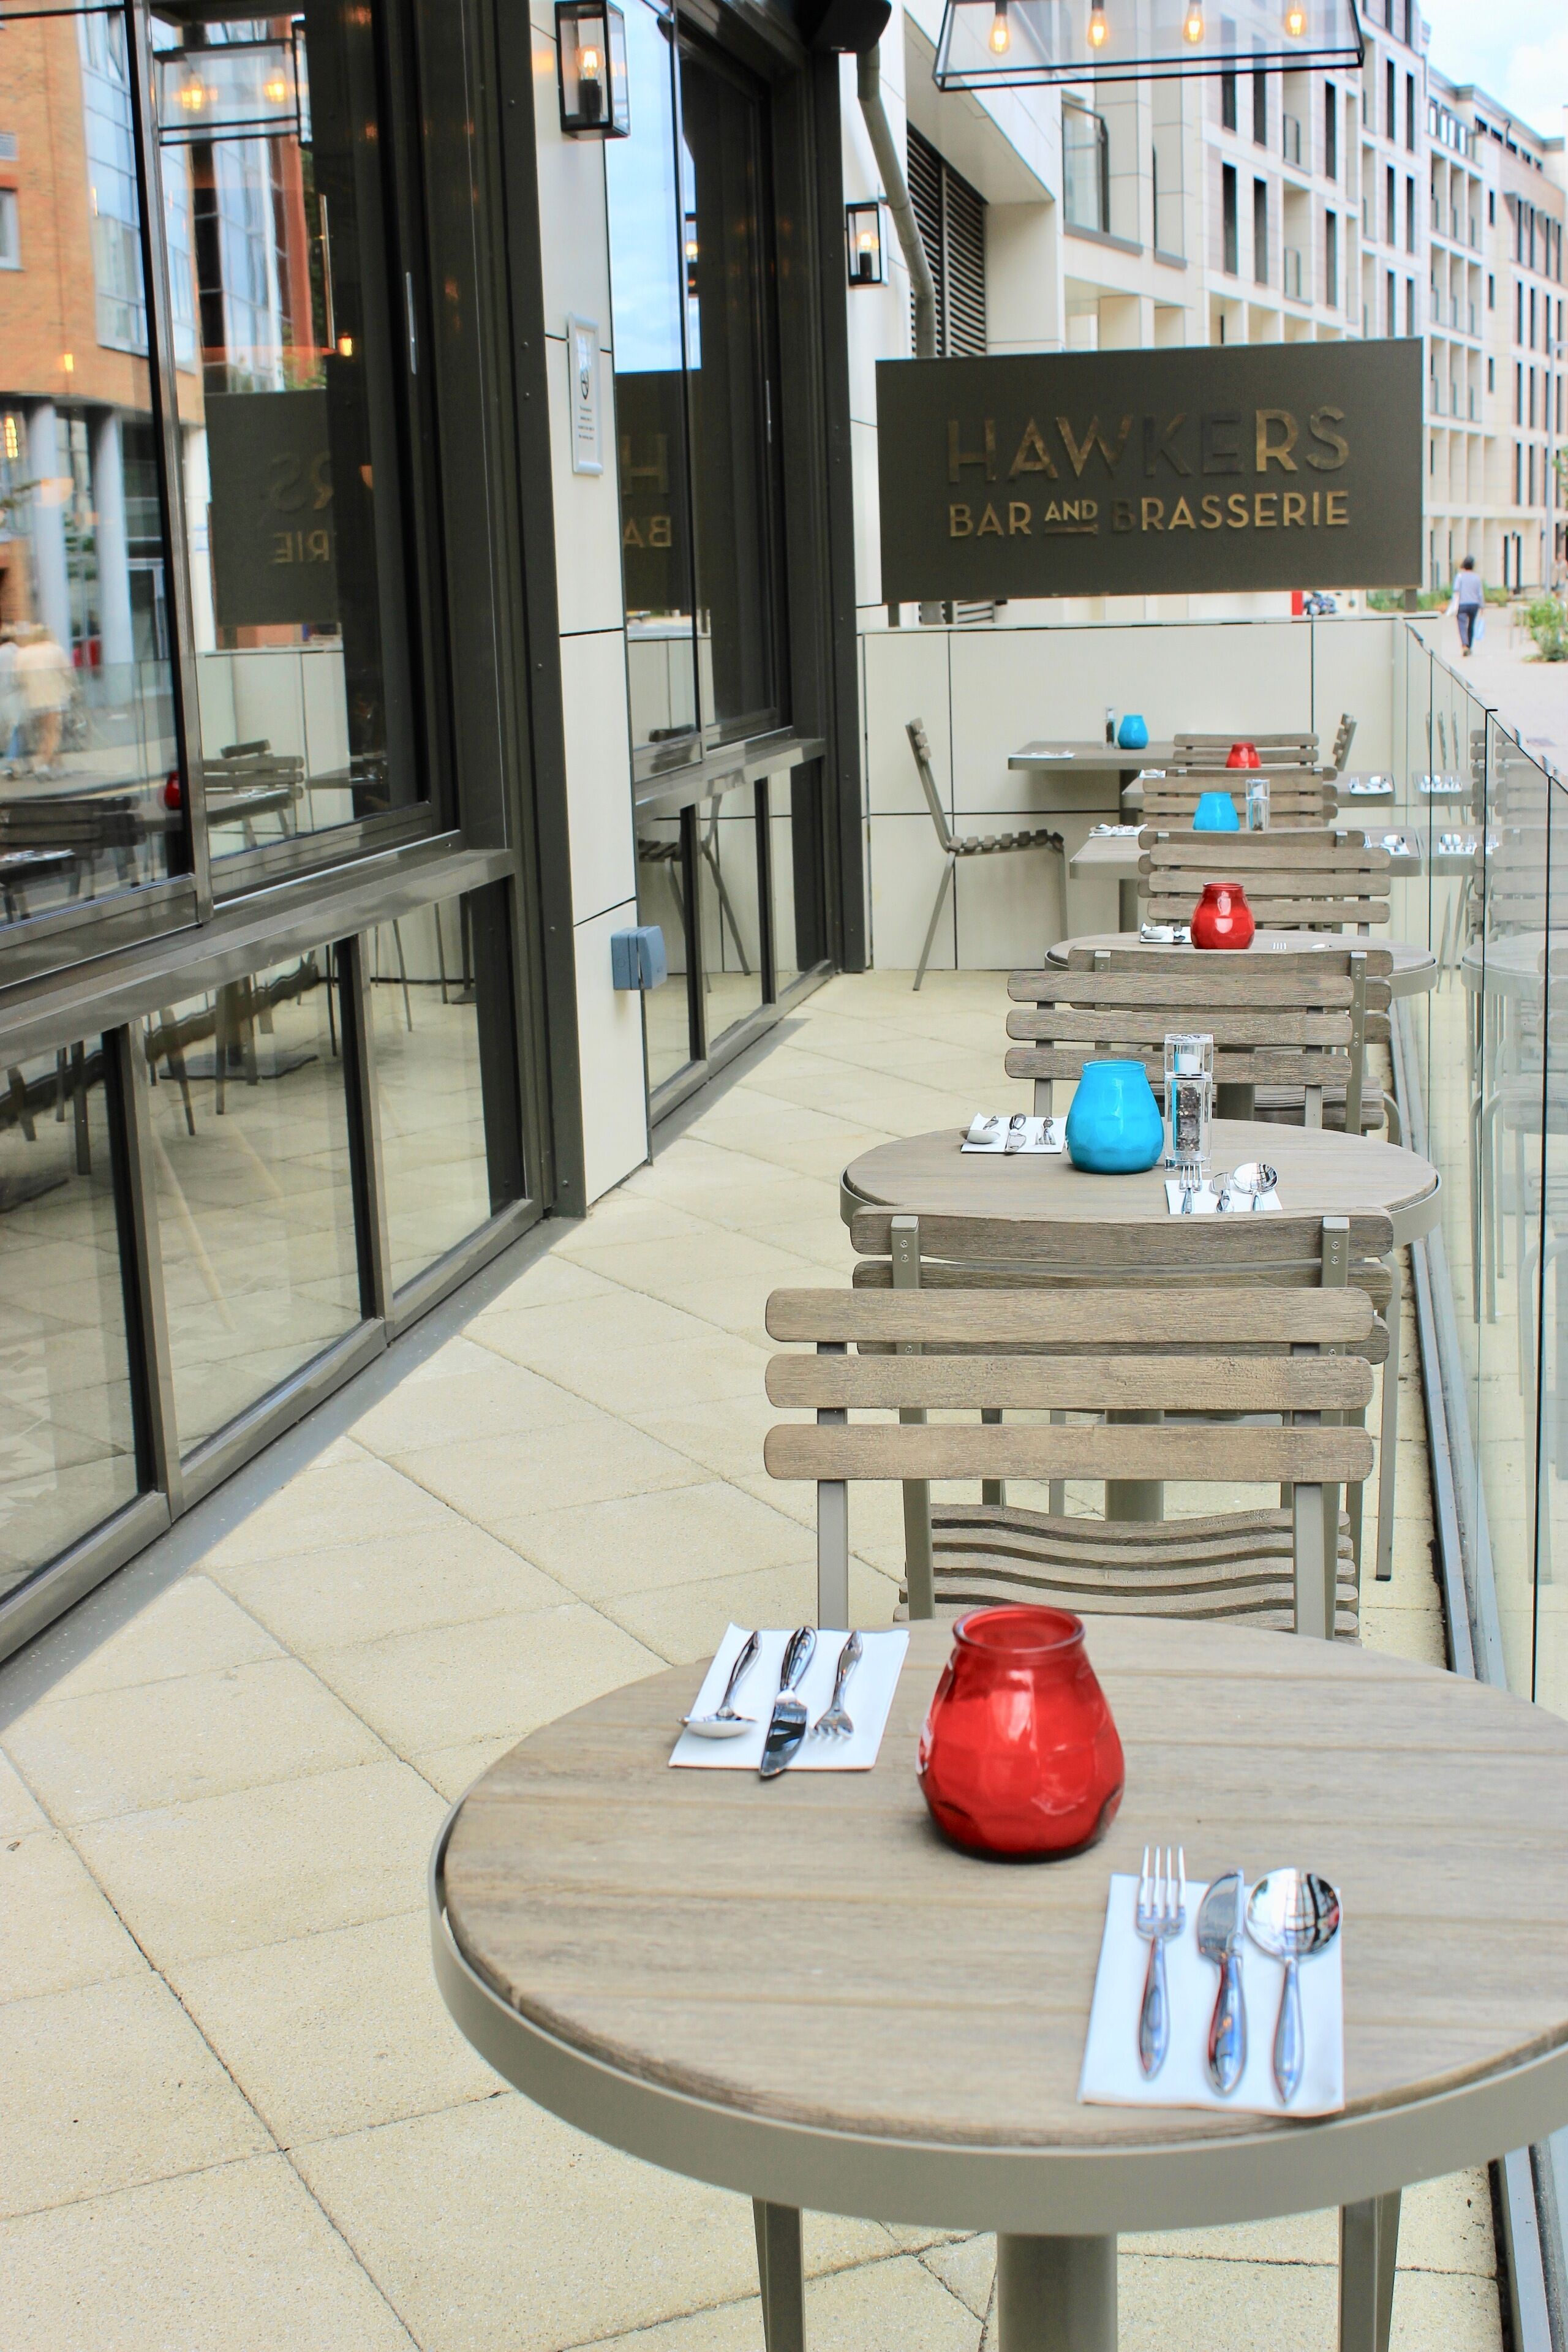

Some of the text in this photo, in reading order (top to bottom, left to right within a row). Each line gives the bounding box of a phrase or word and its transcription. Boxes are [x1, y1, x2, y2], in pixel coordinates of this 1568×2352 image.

[947, 406, 1349, 483] HAWKERS
[949, 491, 1350, 538] BAR AND BRASSERIE
